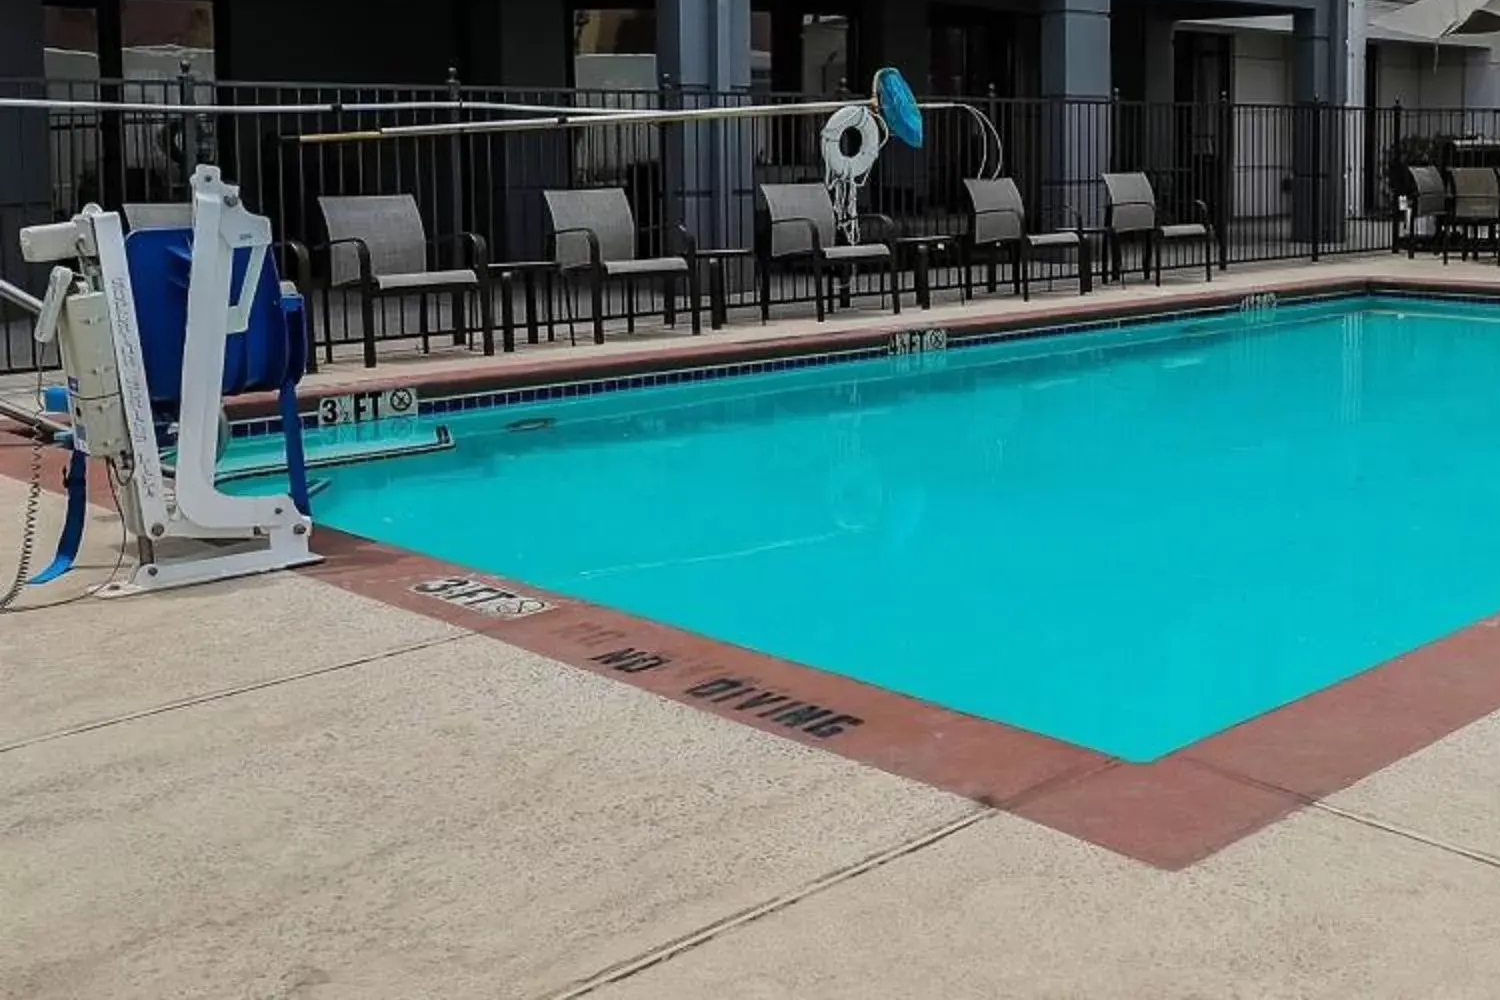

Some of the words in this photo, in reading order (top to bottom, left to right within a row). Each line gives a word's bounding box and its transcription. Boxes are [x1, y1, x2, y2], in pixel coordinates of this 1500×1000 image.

[354, 391, 382, 423] FT
[445, 587, 516, 606] FT
[588, 647, 670, 673] NO
[685, 678, 864, 737] DIVING
